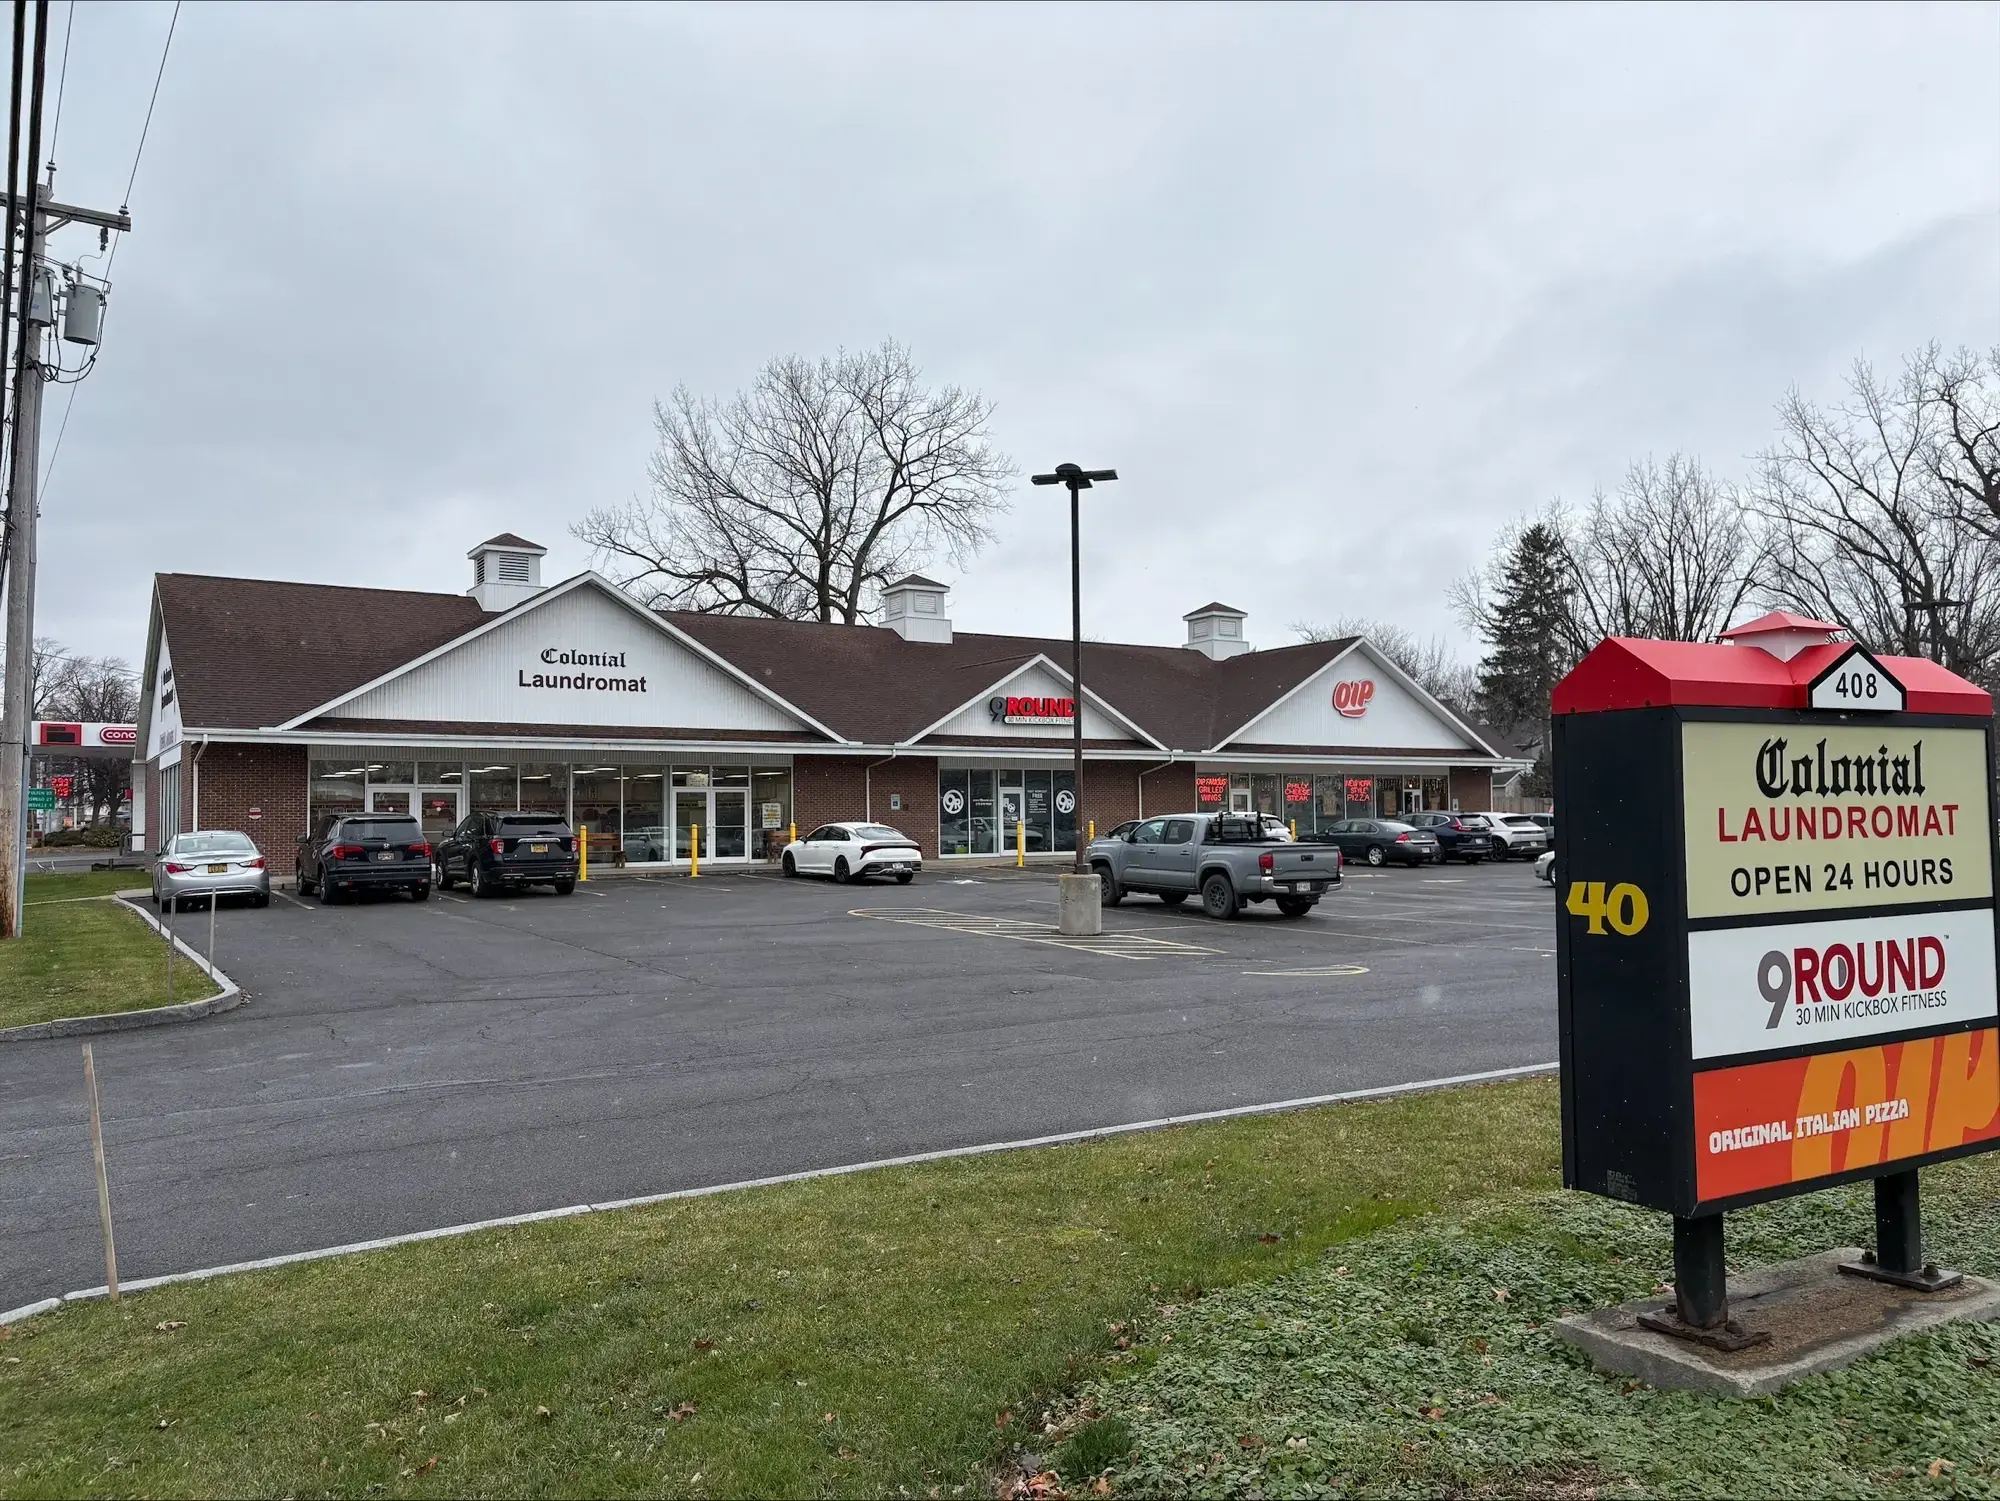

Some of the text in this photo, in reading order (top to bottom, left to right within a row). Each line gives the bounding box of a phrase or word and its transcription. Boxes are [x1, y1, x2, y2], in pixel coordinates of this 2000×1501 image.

[540, 648, 626, 668] Colonial
[519, 669, 647, 692] Laundromat
[1835, 672, 1878, 699] 408
[1015, 716, 1027, 724] MIN
[1055, 717, 1075, 725] FITNES
[1755, 736, 1926, 799] Colonial
[1199, 785, 1224, 794] GRILLED
[1201, 793, 1222, 802] WINGS
[1285, 788, 1311, 796] CHEESE
[1346, 794, 1370, 802] PIZZA
[1350, 786, 1367, 794] STYLE
[1718, 804, 1959, 842] LAUNDROMAT
[1730, 858, 1953, 897] OPEN 24 HOURS
[1565, 881, 1650, 936] 40
[1757, 935, 1946, 1030] 9ROUND
[1796, 990, 1947, 1026] 30 MIN KICKBOX FITNESS
[1709, 1098, 1909, 1154] ORIGINAL ITALIAN PIZZA
